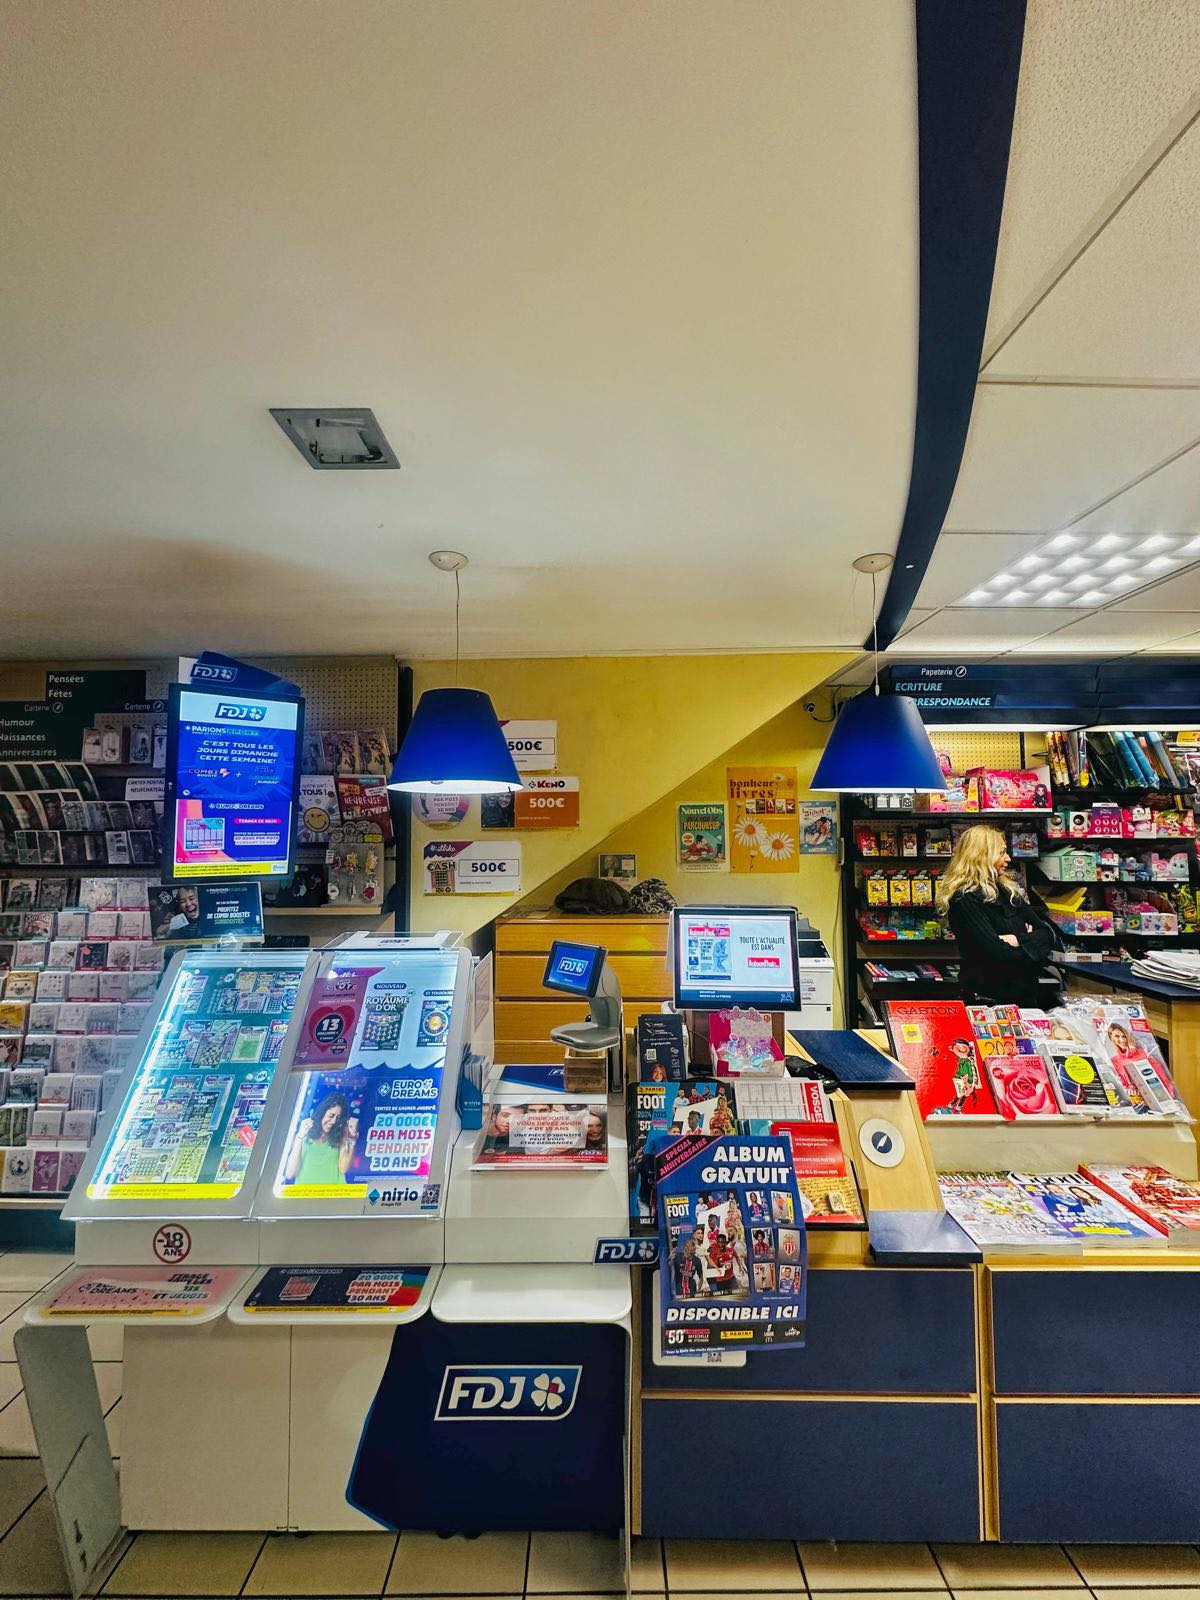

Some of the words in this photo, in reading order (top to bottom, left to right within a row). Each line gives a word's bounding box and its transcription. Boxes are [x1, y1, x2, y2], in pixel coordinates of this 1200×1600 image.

[193, 666, 219, 677] FDJ
[921, 667, 953, 676] Papeterie
[49, 675, 85, 683] Pensées
[895, 682, 943, 692] ECRITURE
[49, 689, 73, 698] Fêtes
[218, 704, 248, 718] FDJ
[0, 748, 57, 756] nniversaires
[230, 749, 279, 757] DIMANCHE
[199, 754, 230, 762] CETTE
[537, 780, 565, 788] KENO
[730, 779, 775, 788] bonheur
[730, 787, 775, 798] livres
[529, 797, 565, 808] 500€
[707, 806, 723, 814] Obs
[427, 861, 456, 871] CASH
[471, 861, 507, 873] 500€
[739, 936, 755, 944] TOUTE
[751, 943, 760, 951] EST
[760, 943, 775, 951] DANS
[559, 960, 575, 971] FDJ
[366, 996, 409, 1005] ROYAUME
[375, 1003, 397, 1012] D'OR
[896, 1006, 958, 1015] GASTON
[322, 1018, 340, 1031] 13
[394, 1081, 422, 1090] EURO
[392, 1089, 437, 1098] DREAMS
[637, 1095, 666, 1110] FOOT
[377, 1116, 393, 1127] 20
[395, 1116, 430, 1127] 000€
[369, 1129, 395, 1140] PAR
[397, 1129, 432, 1140] MOIS
[367, 1142, 429, 1154] PENDANT
[665, 1139, 692, 1161] SPÉCIAL
[659, 1137, 708, 1177] ANNIVERSAIRE
[713, 1146, 785, 1162] ALBUM
[373, 1156, 390, 1168] 30
[392, 1156, 418, 1168] ANS
[382, 1187, 419, 1202] nirio
[667, 1204, 690, 1218] FOOT
[157, 1232, 184, 1248] -18
[163, 1248, 183, 1257] ANS
[598, 1242, 636, 1260] FDJ
[667, 1306, 770, 1322] DISPONIBLE
[776, 1305, 799, 1319] ICI
[448, 1376, 526, 1410] FDJ
